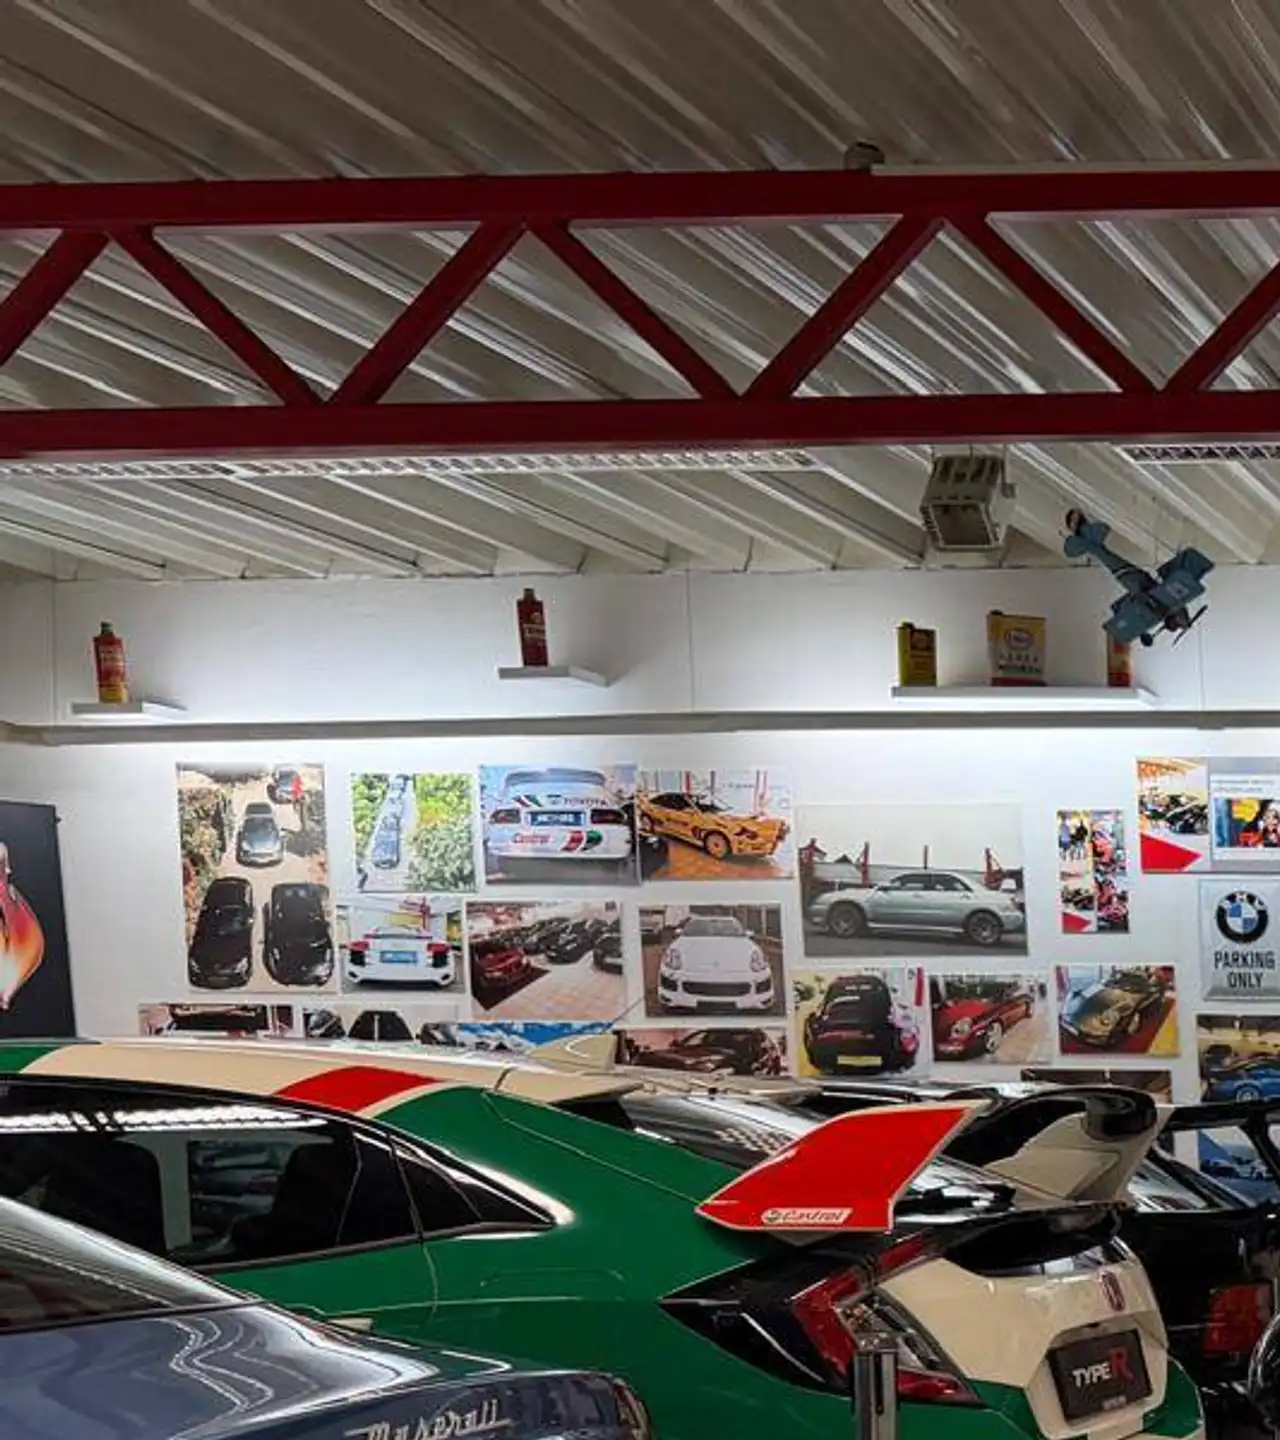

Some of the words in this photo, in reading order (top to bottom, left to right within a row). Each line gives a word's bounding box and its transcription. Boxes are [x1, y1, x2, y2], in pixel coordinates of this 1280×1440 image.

[1214, 951, 1275, 969] PARKING
[1227, 971, 1263, 988] ONLY
[783, 1209, 844, 1221] Castrol
[1072, 1360, 1112, 1388] TYPE
[1109, 1346, 1134, 1382] R
